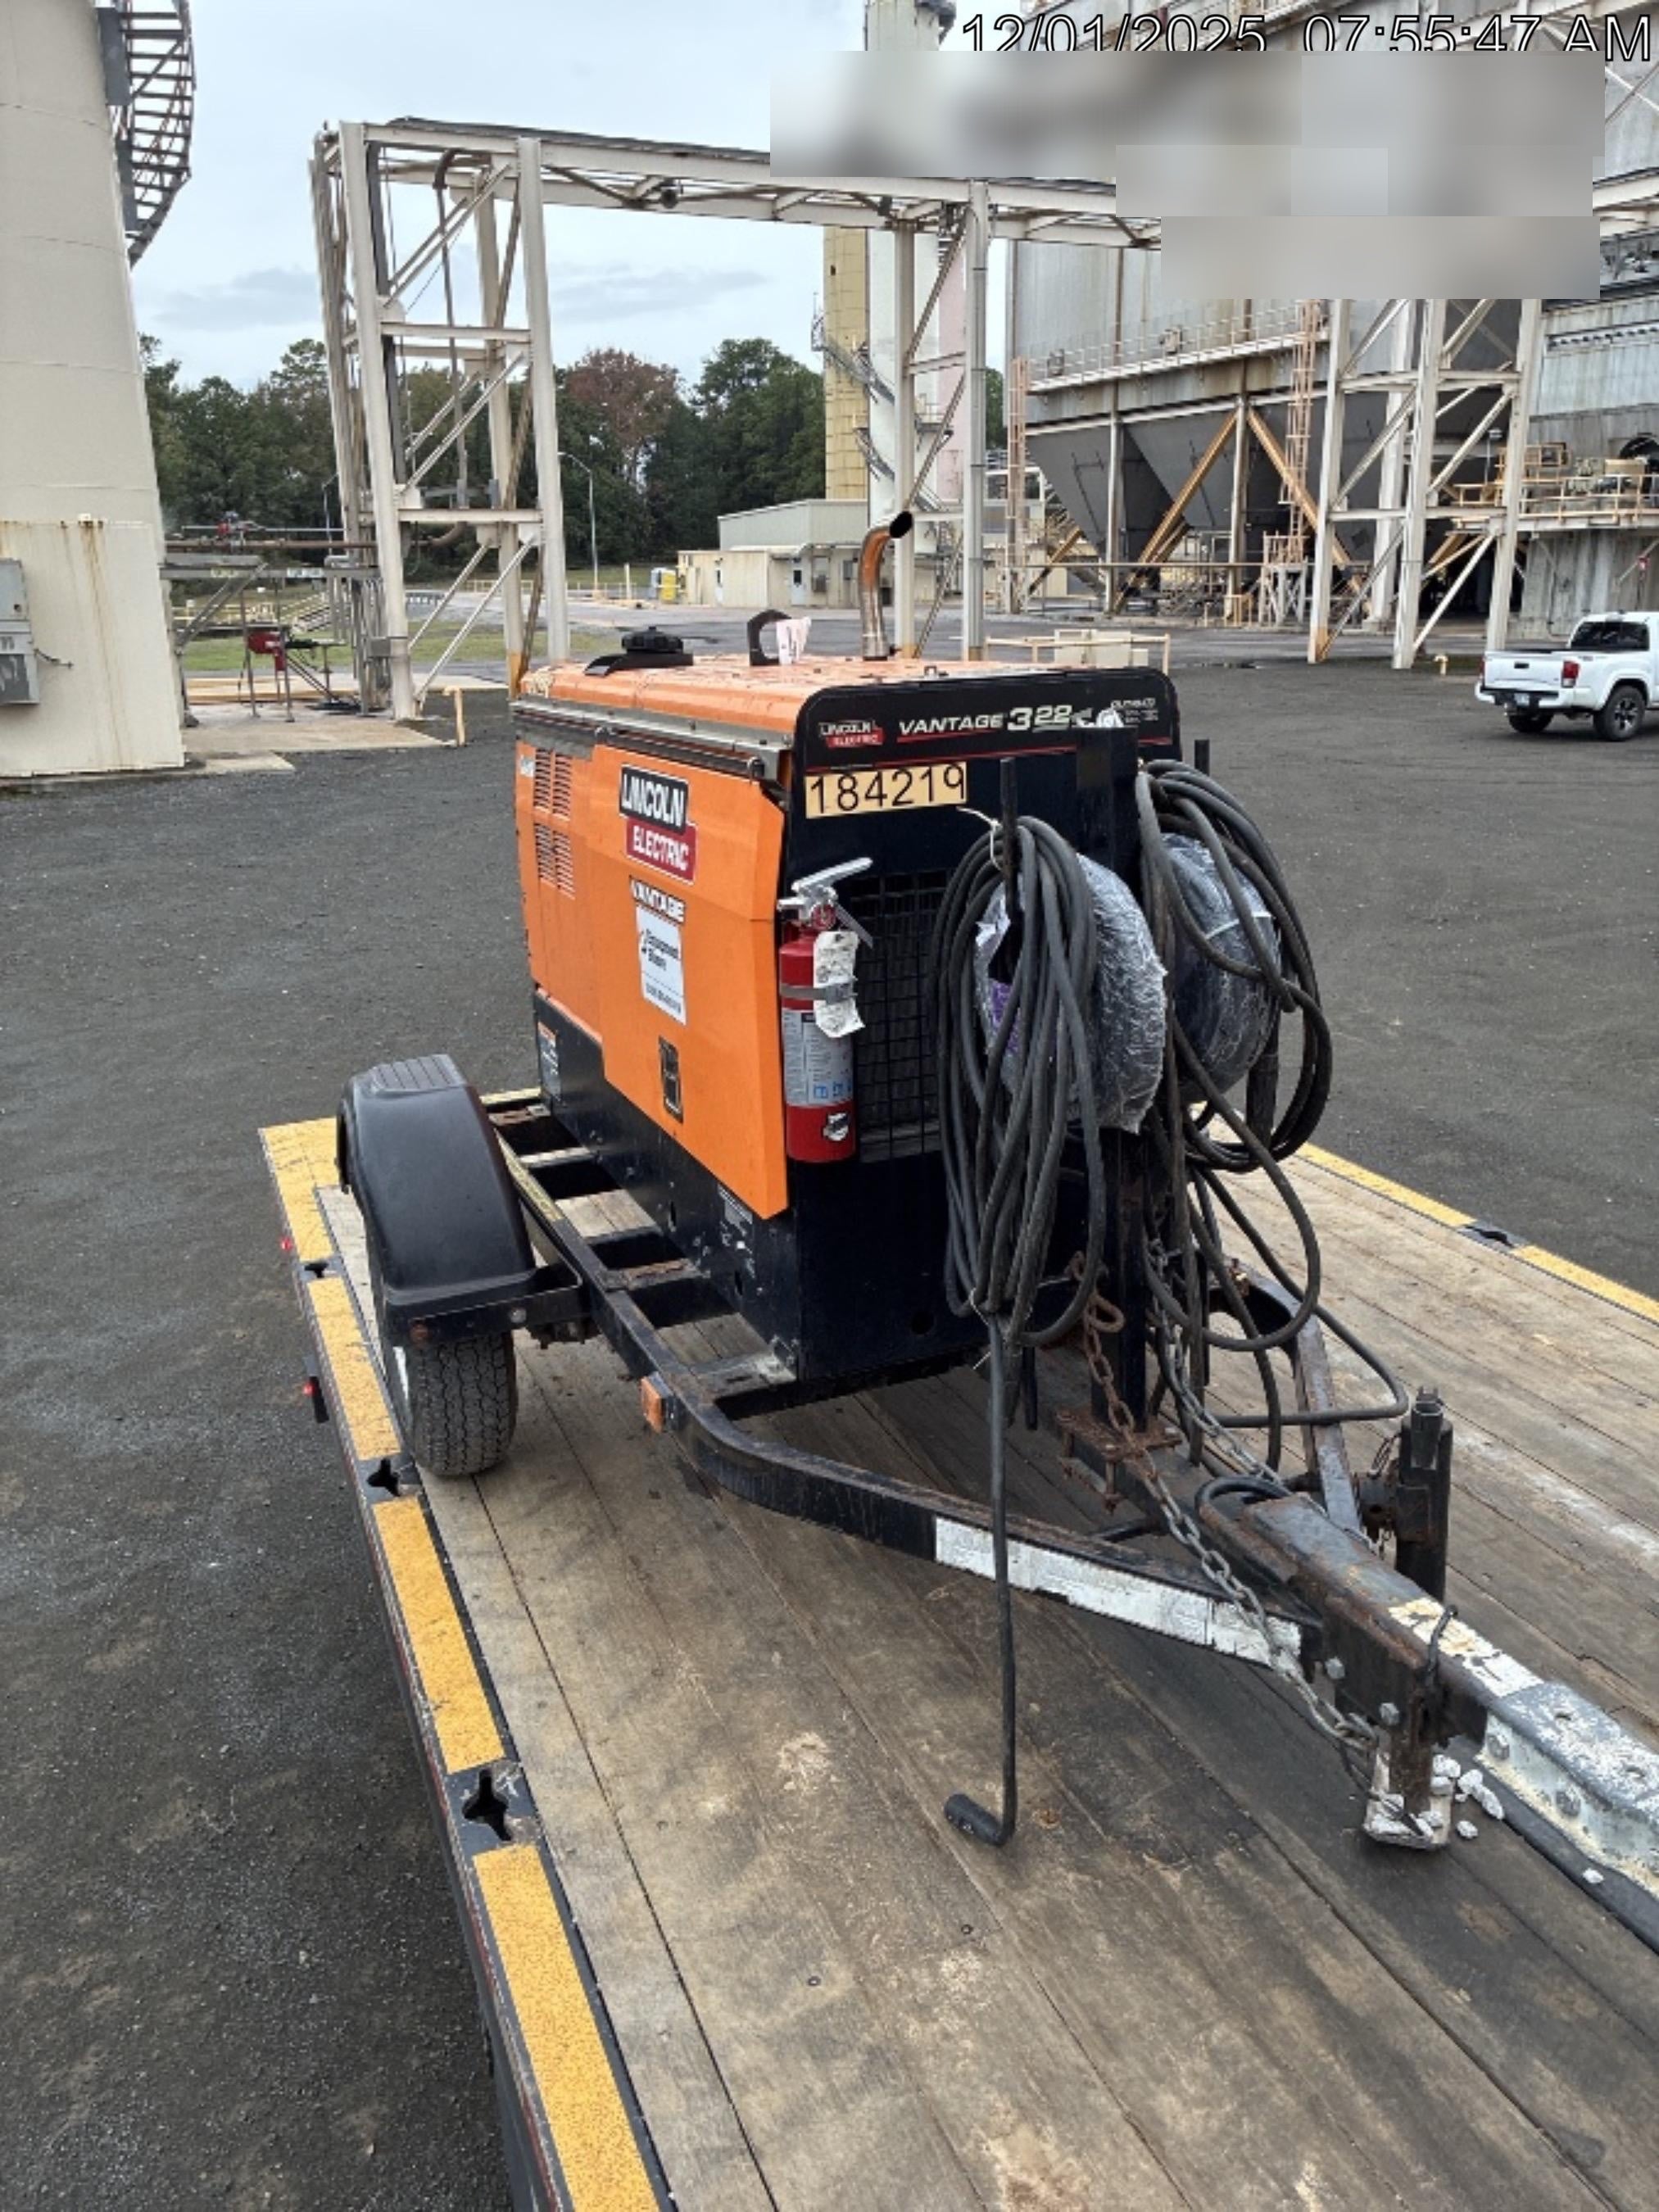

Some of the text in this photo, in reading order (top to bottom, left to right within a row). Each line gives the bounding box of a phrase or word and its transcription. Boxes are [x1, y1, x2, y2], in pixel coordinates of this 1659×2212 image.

[899, 714, 1004, 735] VANTAGE
[621, 773, 686, 827] LINCOLN
[810, 764, 964, 814] 184219
[632, 824, 690, 872] ELECTRIC
